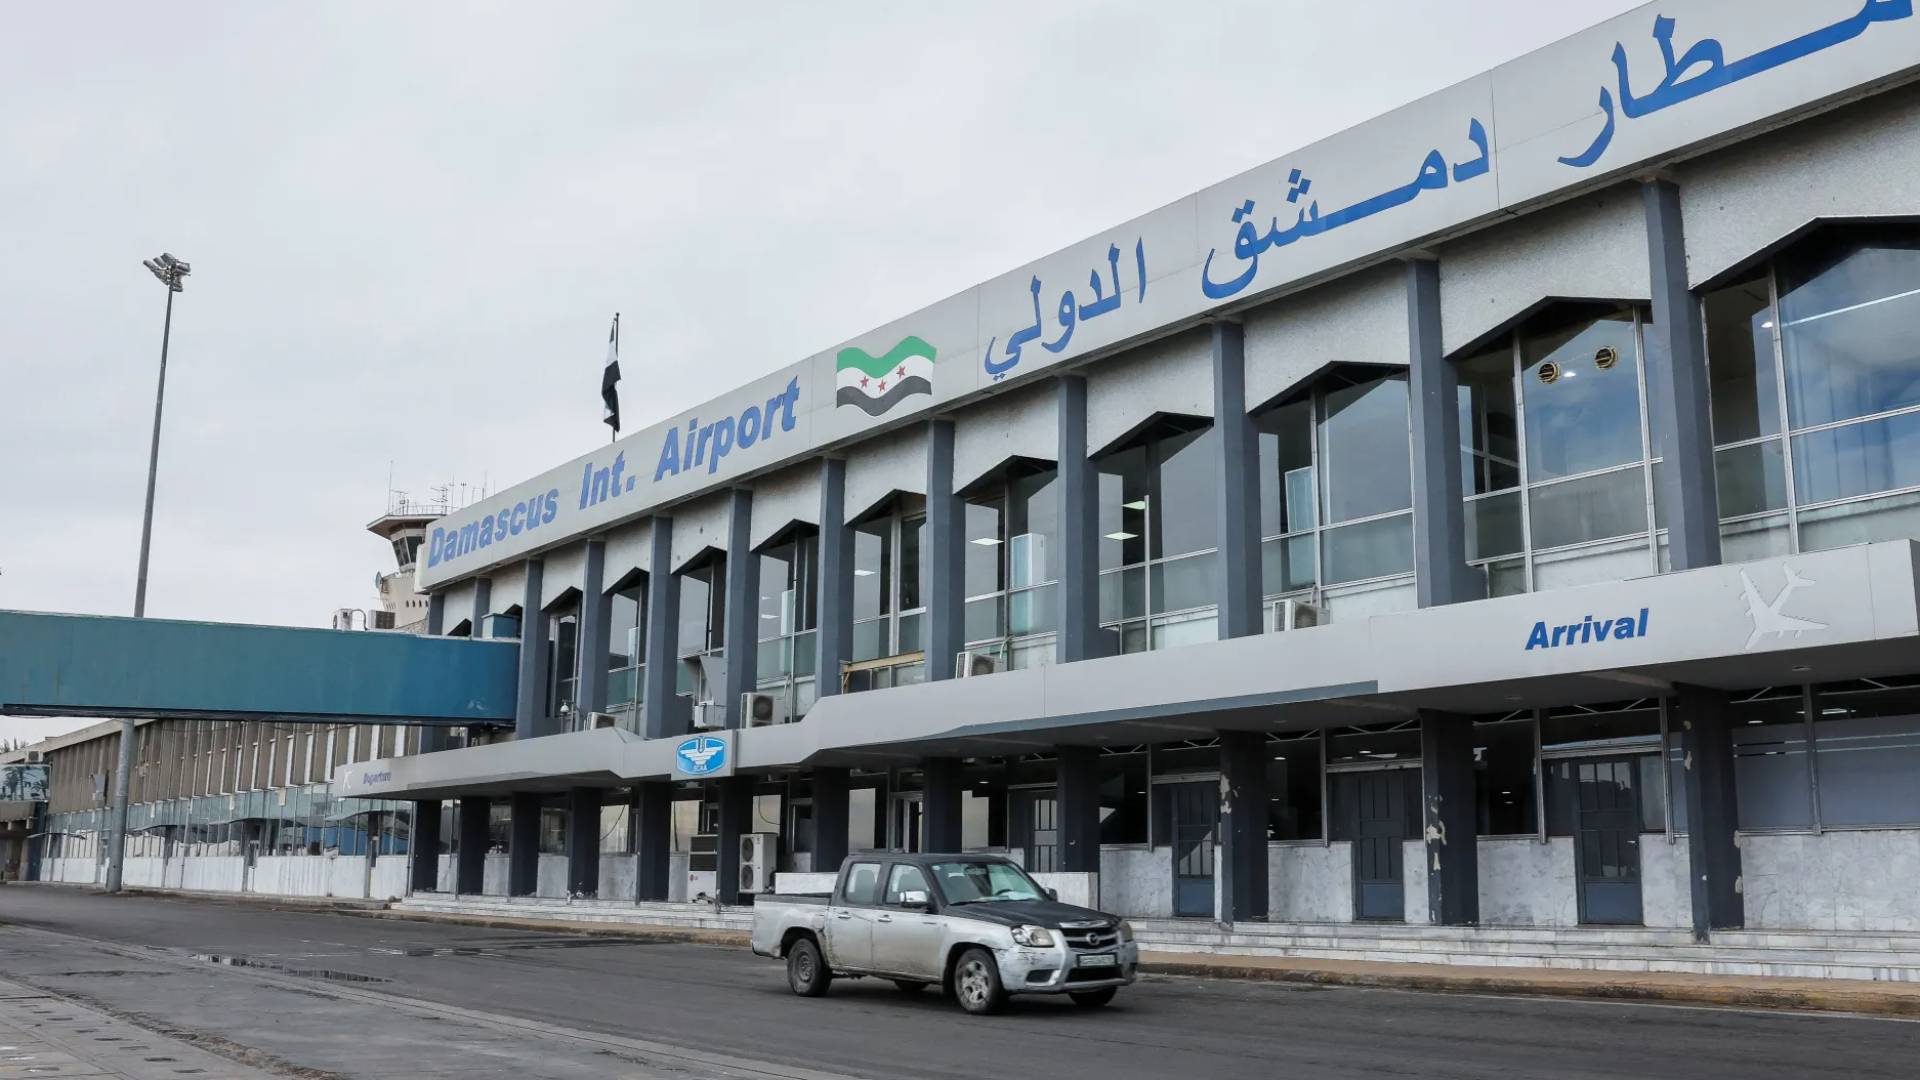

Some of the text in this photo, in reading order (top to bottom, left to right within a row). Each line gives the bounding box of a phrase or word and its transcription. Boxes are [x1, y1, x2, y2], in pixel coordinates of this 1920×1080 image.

[1201, 118, 1490, 301] دمشق
[984, 235, 1147, 382] الدولي
[428, 376, 801, 568] Damascus Int. Airport
[1525, 608, 1649, 651] Arrival
